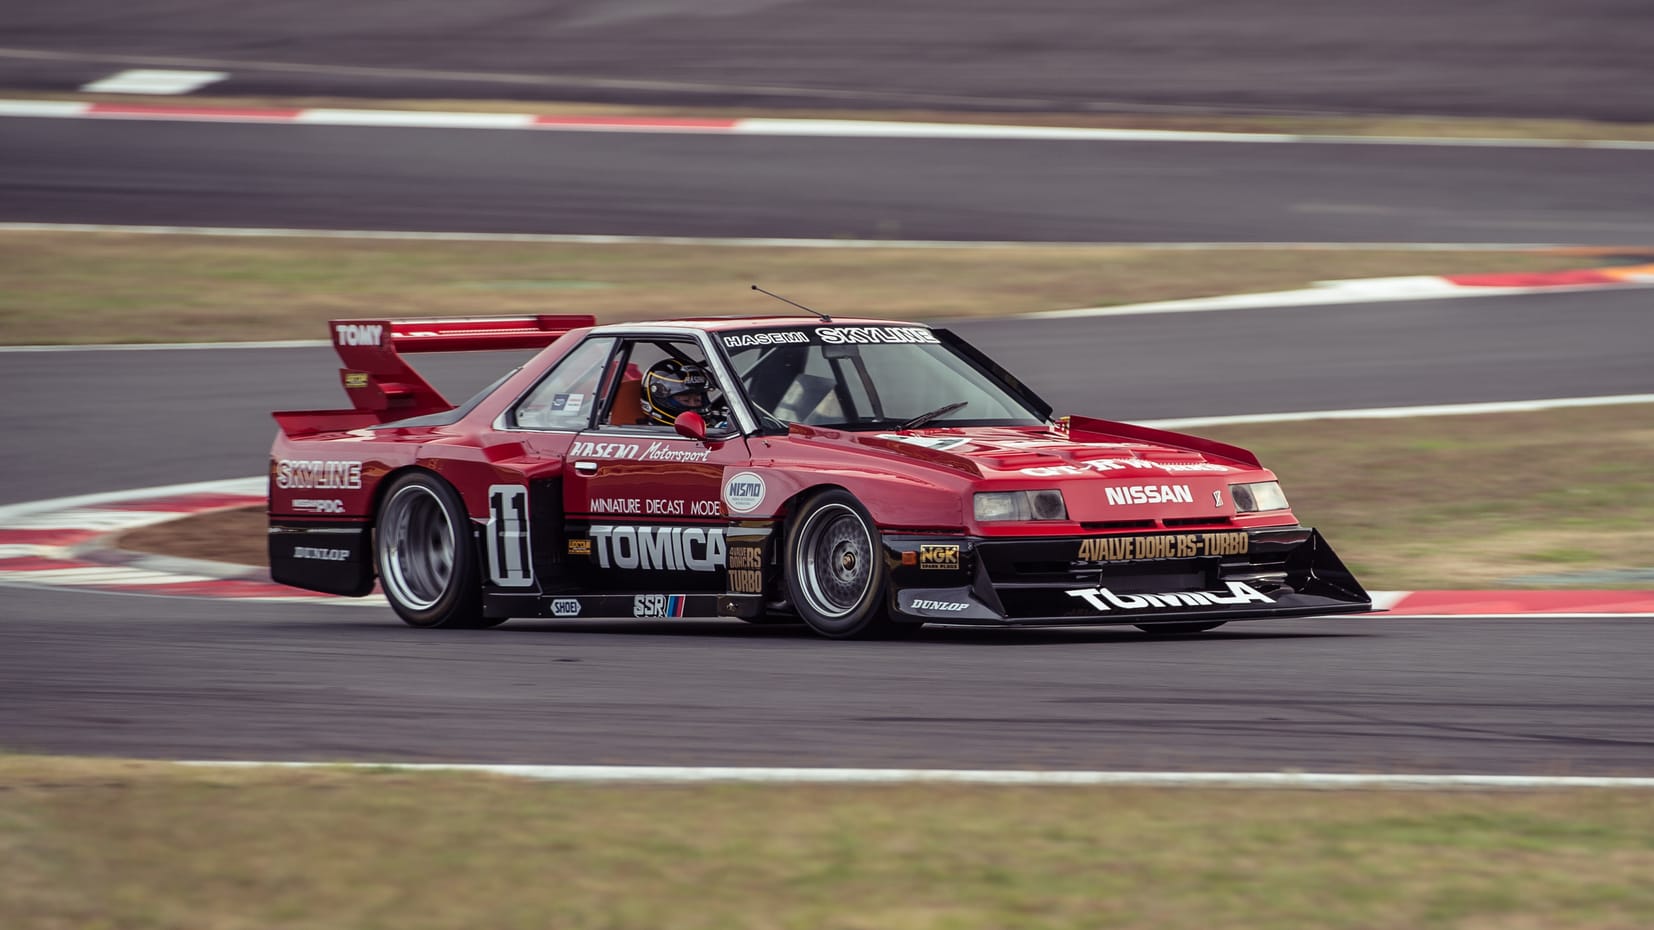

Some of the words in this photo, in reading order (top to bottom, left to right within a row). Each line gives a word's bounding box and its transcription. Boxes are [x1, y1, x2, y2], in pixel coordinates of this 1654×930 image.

[336, 325, 383, 346] TOMY
[723, 331, 810, 347] HASEMI
[814, 327, 942, 344] SKYLINE
[638, 441, 712, 462] Motorsport
[276, 459, 362, 489] SKYLINE
[729, 482, 761, 497] NISMO
[1104, 484, 1193, 505] NISSAN
[590, 498, 641, 513] MINIATURE
[646, 499, 685, 514] DIECAST
[490, 492, 531, 579] 11
[1078, 537, 1134, 561] 4VALVE
[1135, 535, 1176, 559] DOHC
[1177, 531, 1249, 558] RS-TURBO
[293, 546, 351, 561] DUNLOP
[589, 525, 727, 572] TOMICA
[747, 547, 762, 568] RS
[921, 546, 958, 563] NGK
[728, 569, 762, 593] TURBO
[554, 601, 578, 614] SHOEI
[633, 594, 666, 618] SSR
[911, 599, 970, 611] DUNLOP
